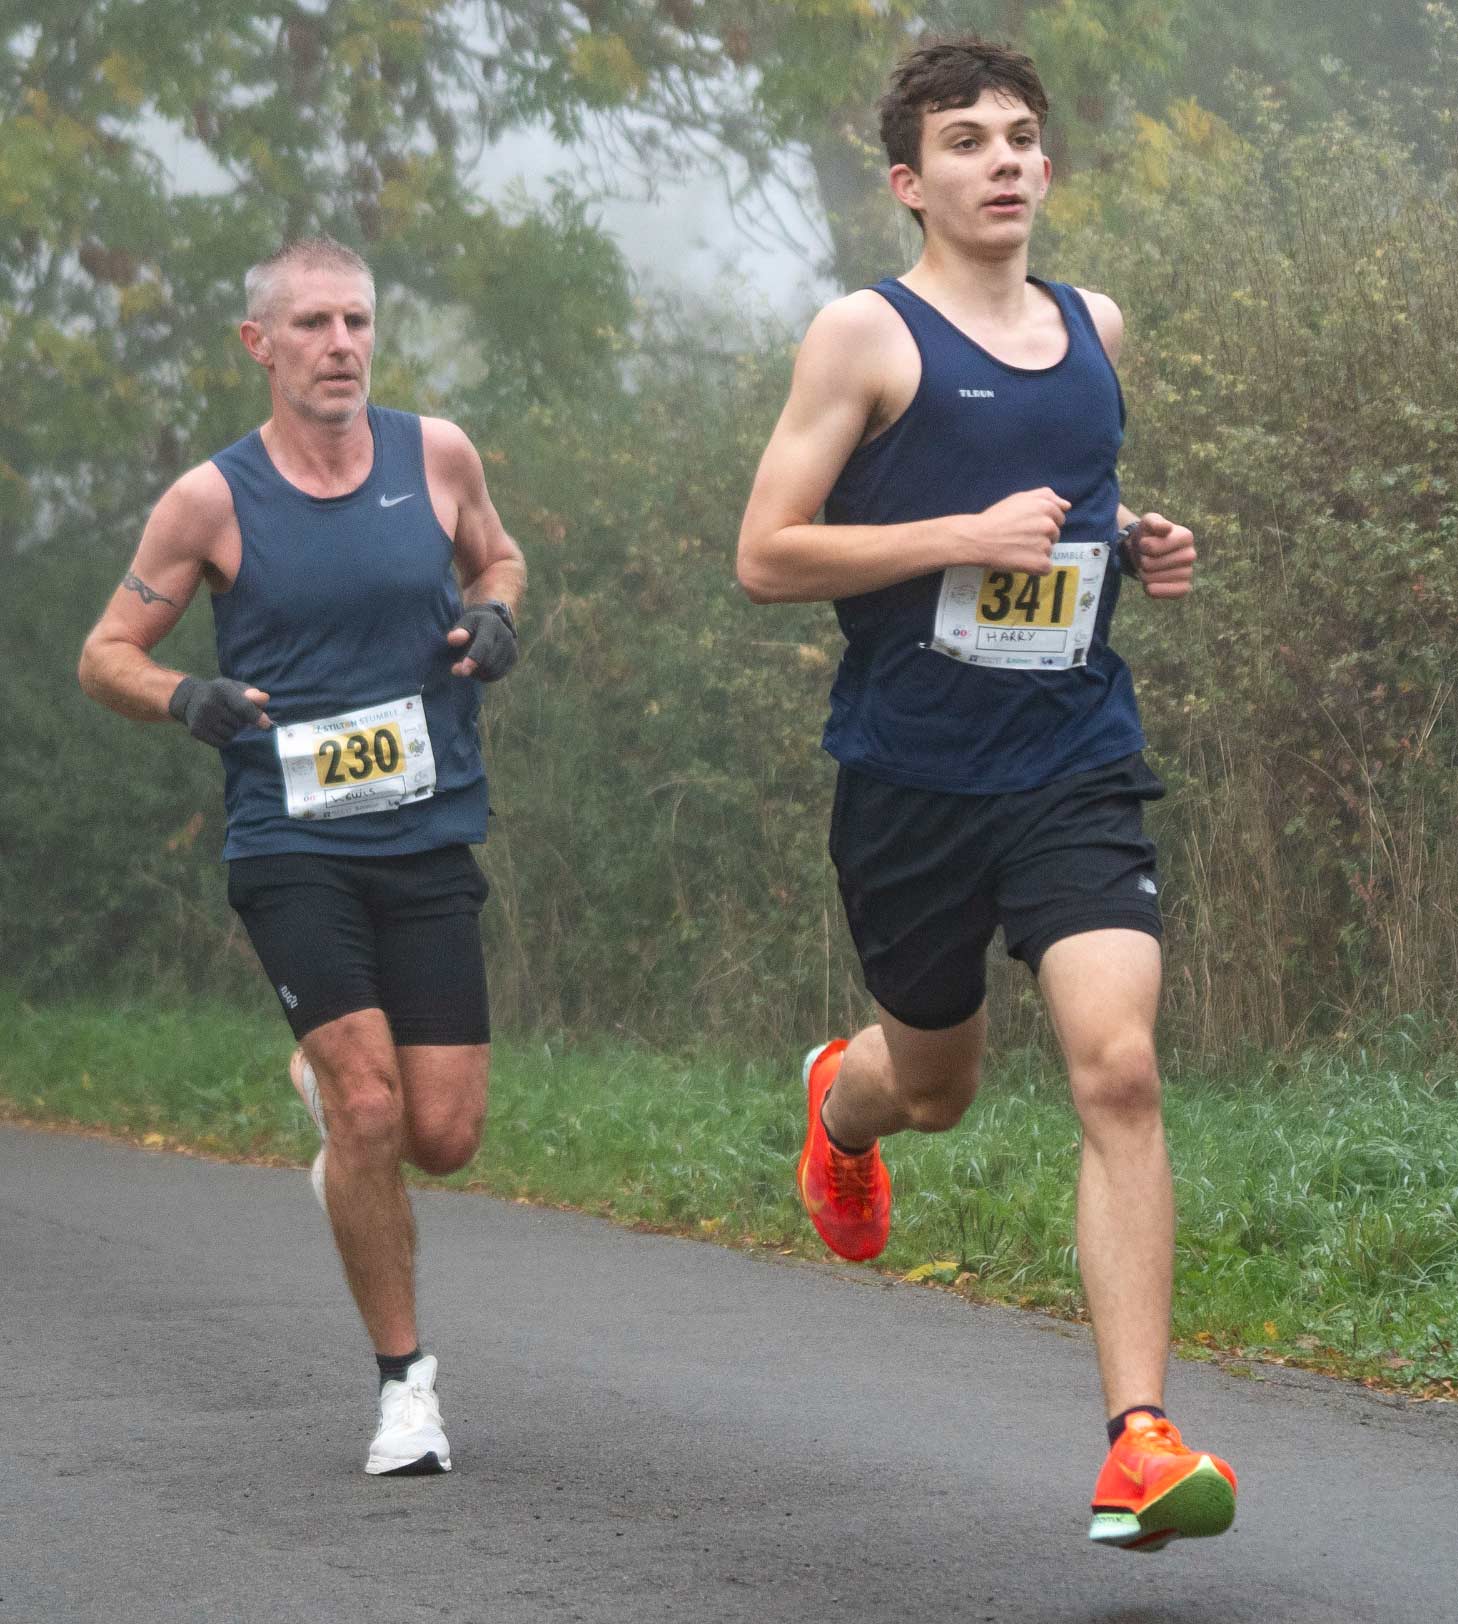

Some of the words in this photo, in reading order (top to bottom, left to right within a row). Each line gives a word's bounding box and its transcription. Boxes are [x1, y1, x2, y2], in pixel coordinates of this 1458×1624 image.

[1053, 551, 1084, 561] UMBLE
[981, 570, 1067, 623] 341
[987, 631, 1037, 642] HARRY
[318, 728, 399, 785] 230
